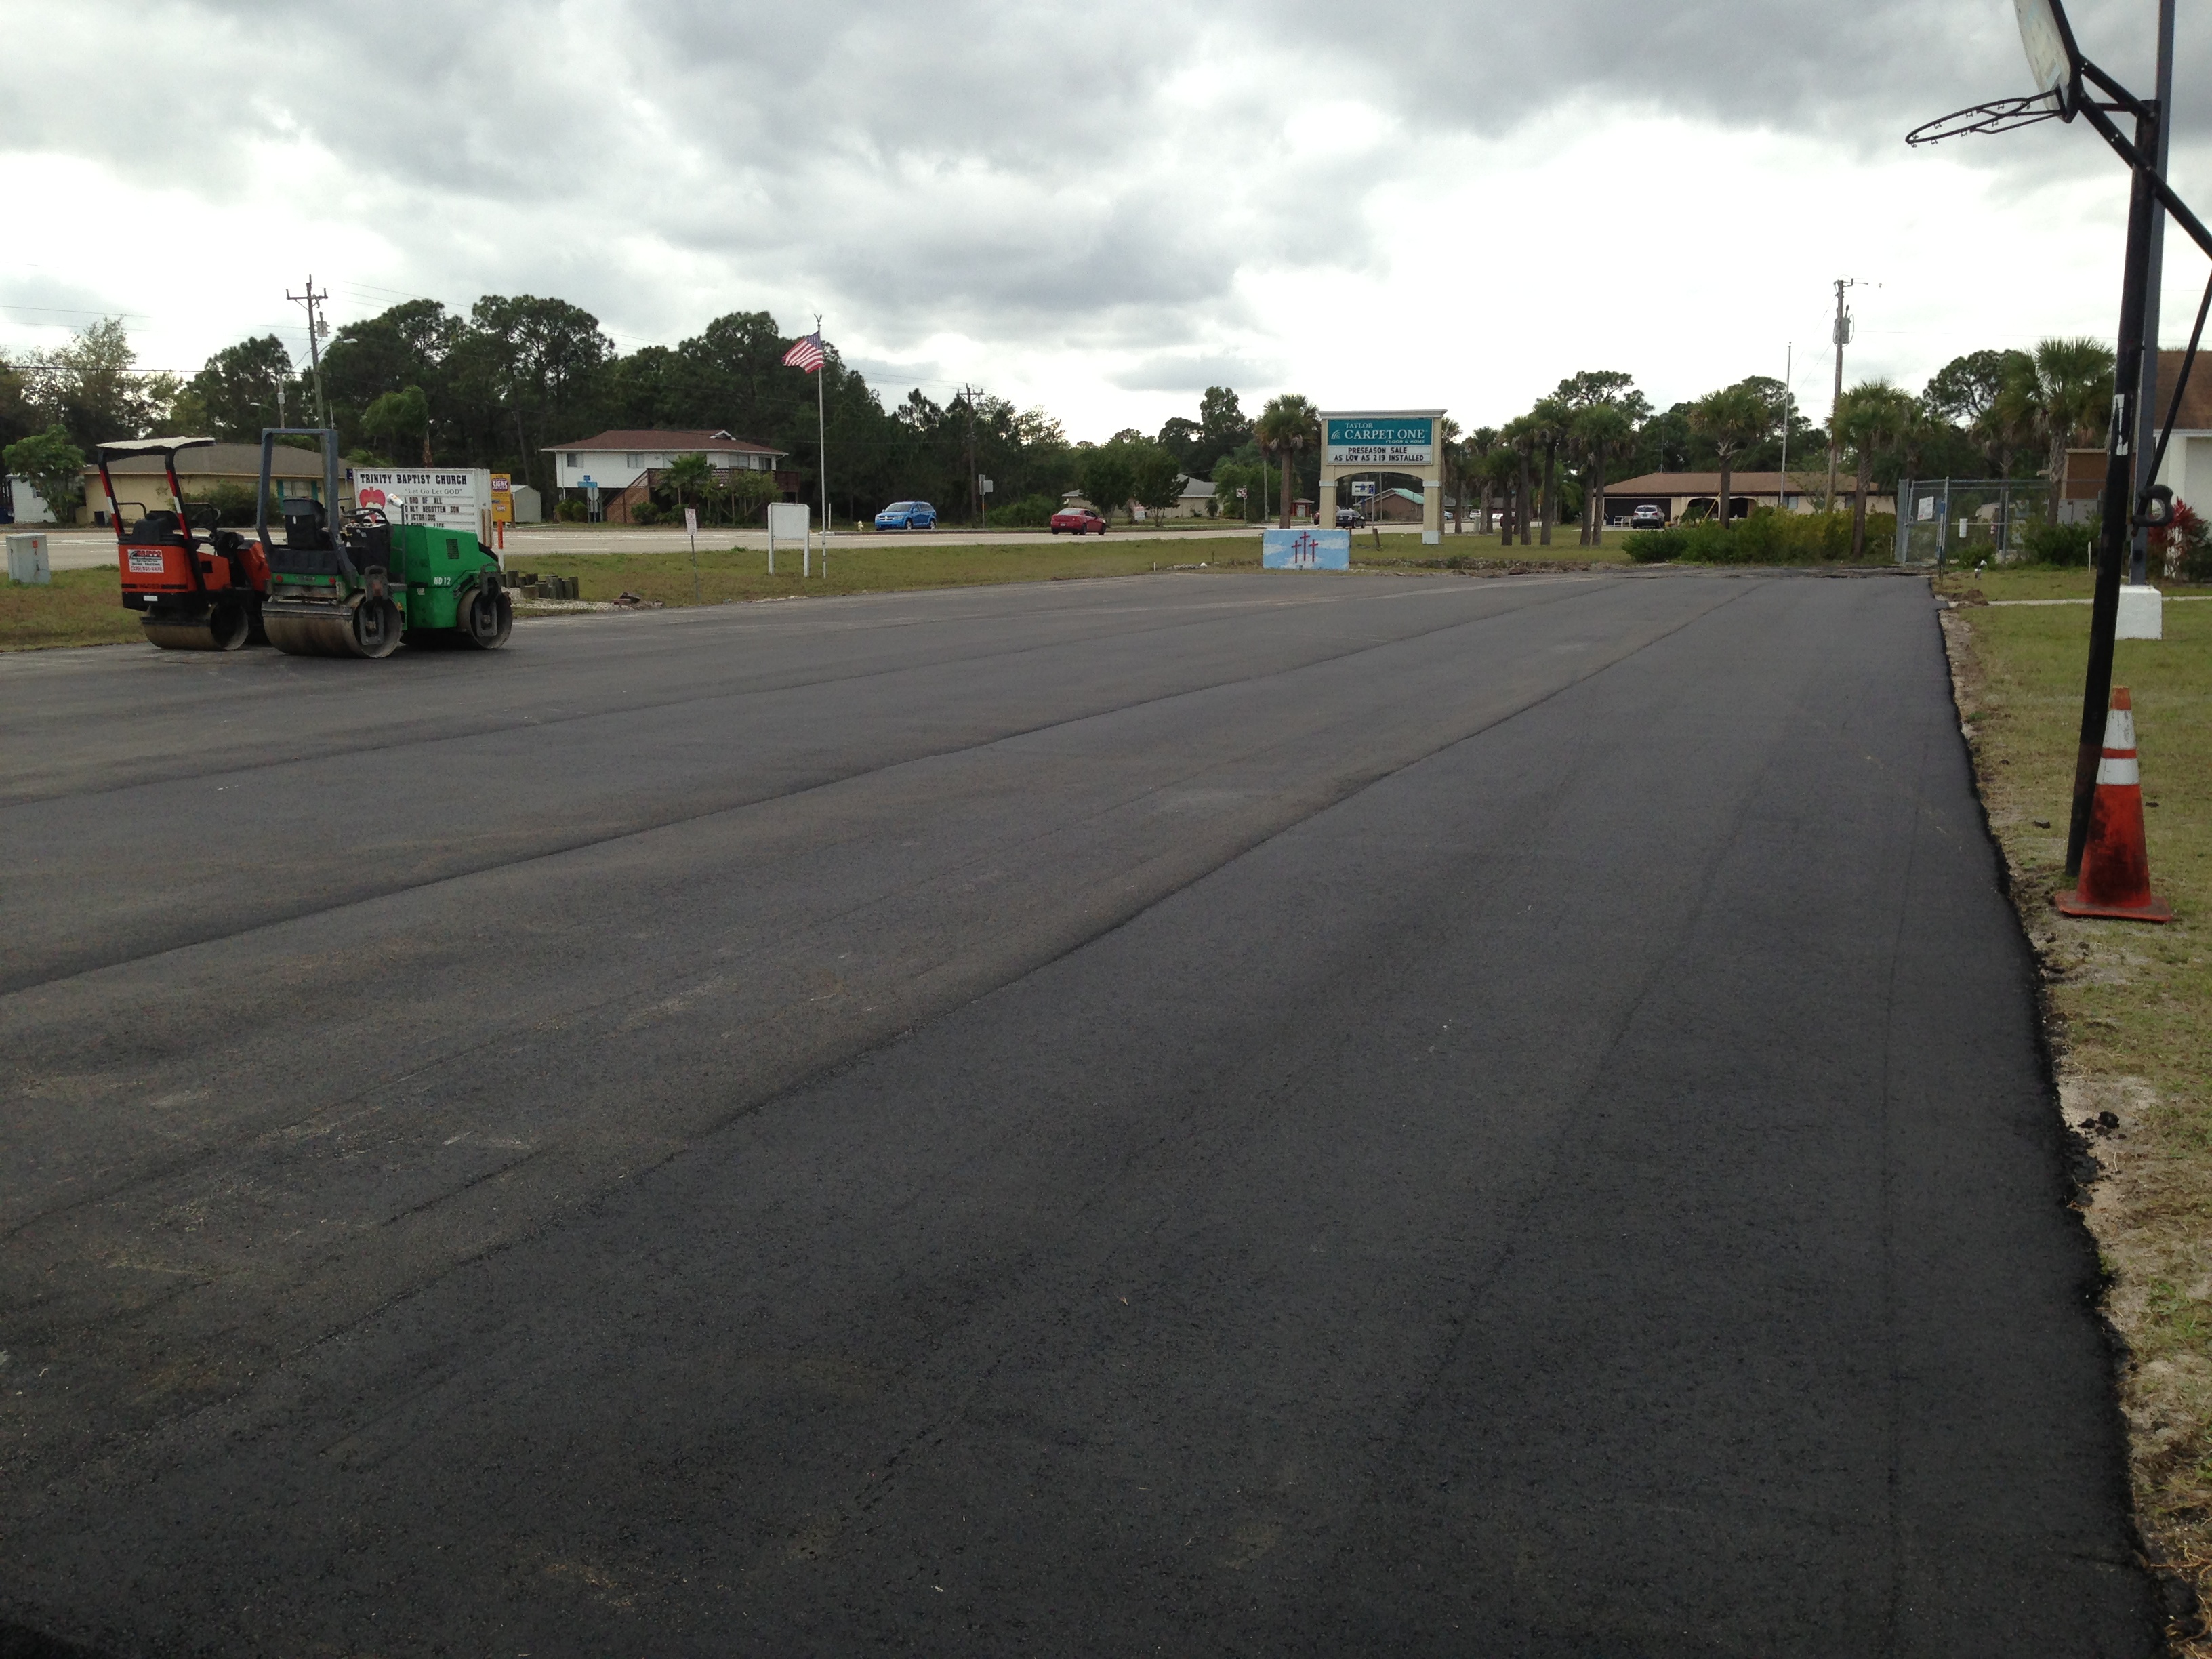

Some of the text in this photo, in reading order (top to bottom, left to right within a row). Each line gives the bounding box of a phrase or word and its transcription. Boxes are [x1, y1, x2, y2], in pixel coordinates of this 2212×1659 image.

[1345, 429, 1425, 440] CARPET ONE
[360, 474, 467, 485] TRINITY BAPTIST CHURCH
